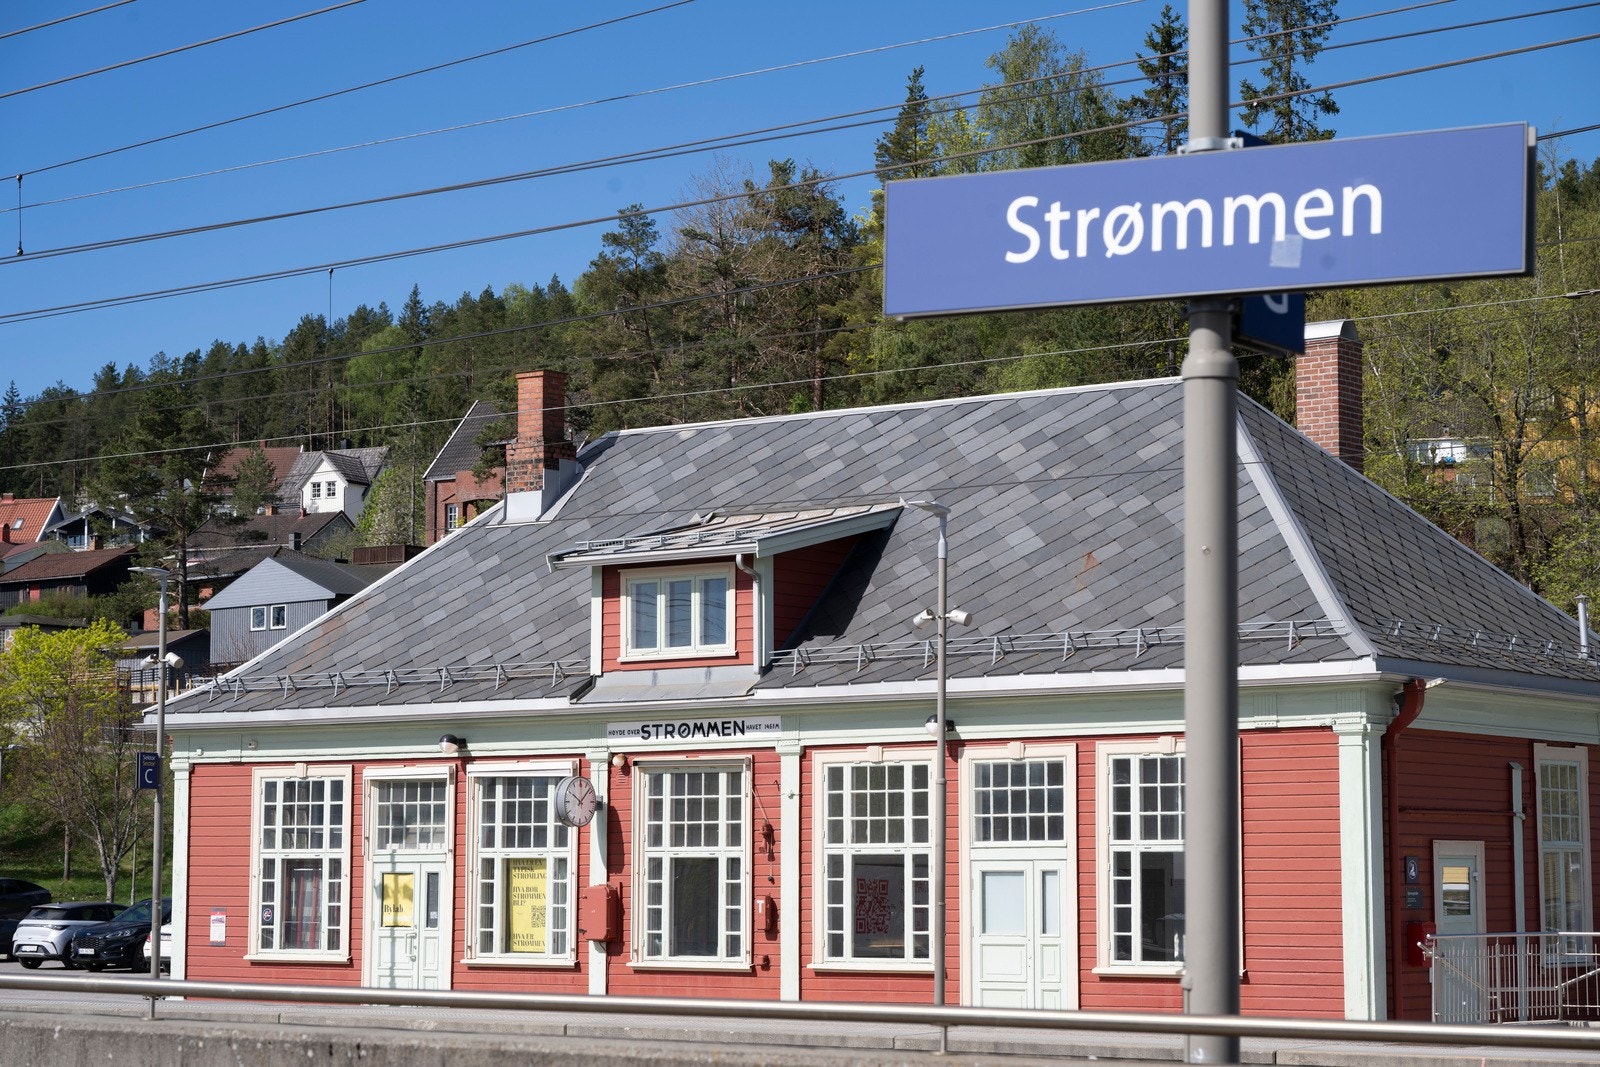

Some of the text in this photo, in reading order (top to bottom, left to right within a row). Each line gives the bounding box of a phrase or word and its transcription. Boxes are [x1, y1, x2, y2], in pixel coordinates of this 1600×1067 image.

[1005, 184, 1383, 264] Strømmen
[640, 720, 746, 741] STRØMMEN
[144, 768, 153, 784] C
[756, 899, 765, 914] T
